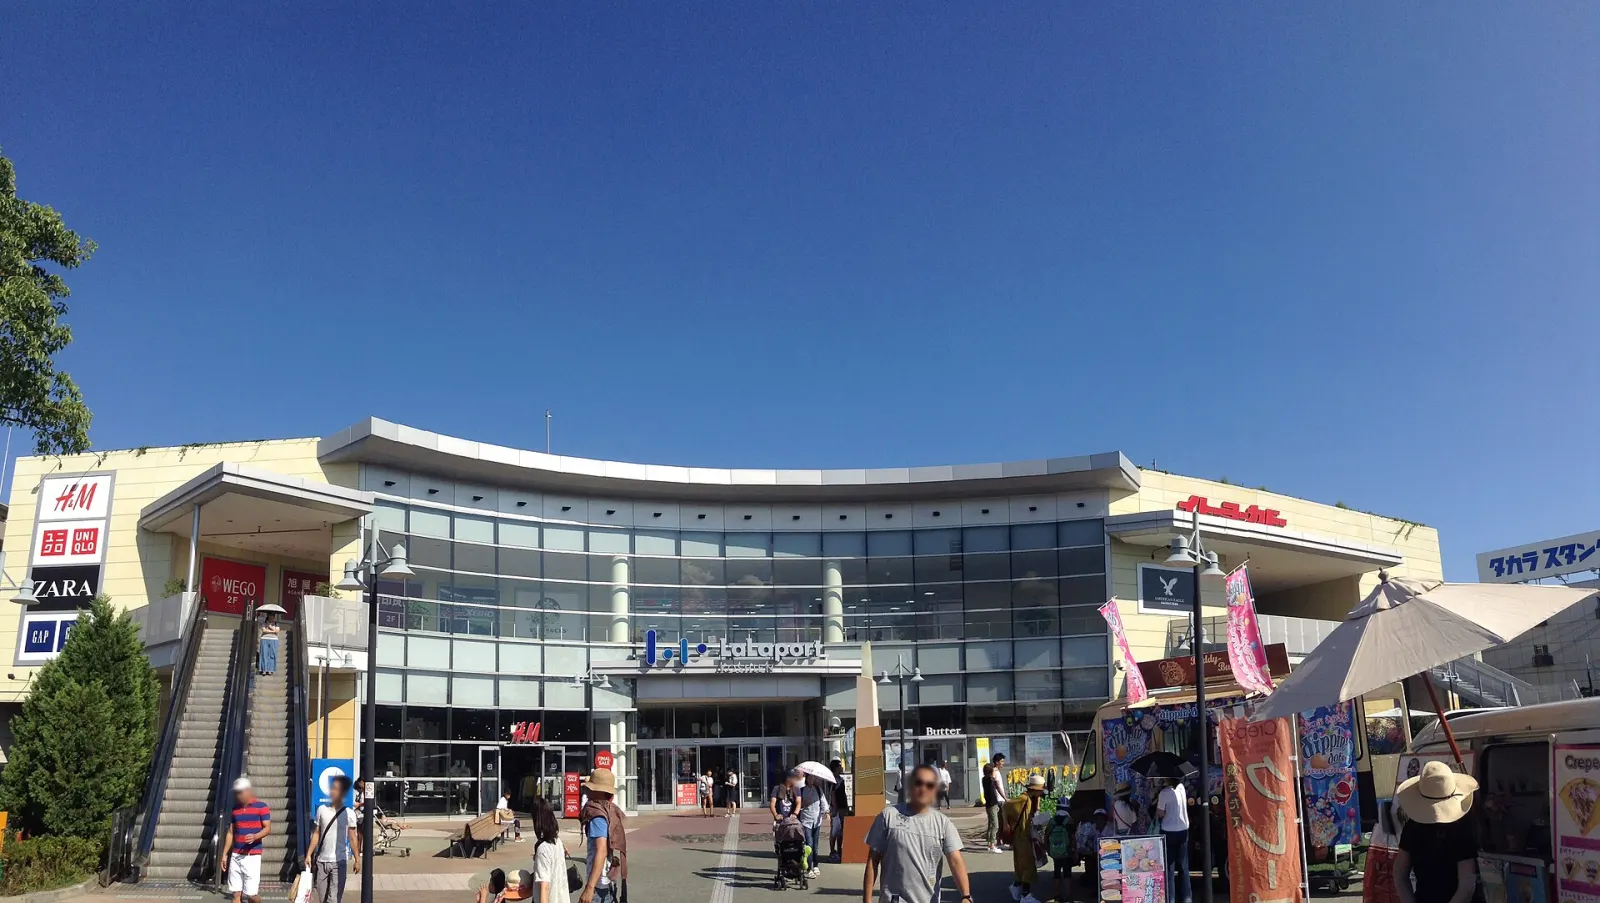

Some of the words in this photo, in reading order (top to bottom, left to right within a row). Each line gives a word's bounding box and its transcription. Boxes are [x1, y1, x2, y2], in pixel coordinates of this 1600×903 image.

[54, 482, 98, 512] H&M
[75, 531, 94, 541] UNI
[74, 541, 94, 553] QLO
[33, 579, 93, 598] ZARA
[223, 578, 256, 596] WEGO
[227, 596, 238, 604] 2F
[386, 614, 396, 622] 2F
[32, 630, 50, 643] GAP
[511, 721, 541, 744] H&M
[926, 727, 961, 736] Butter
